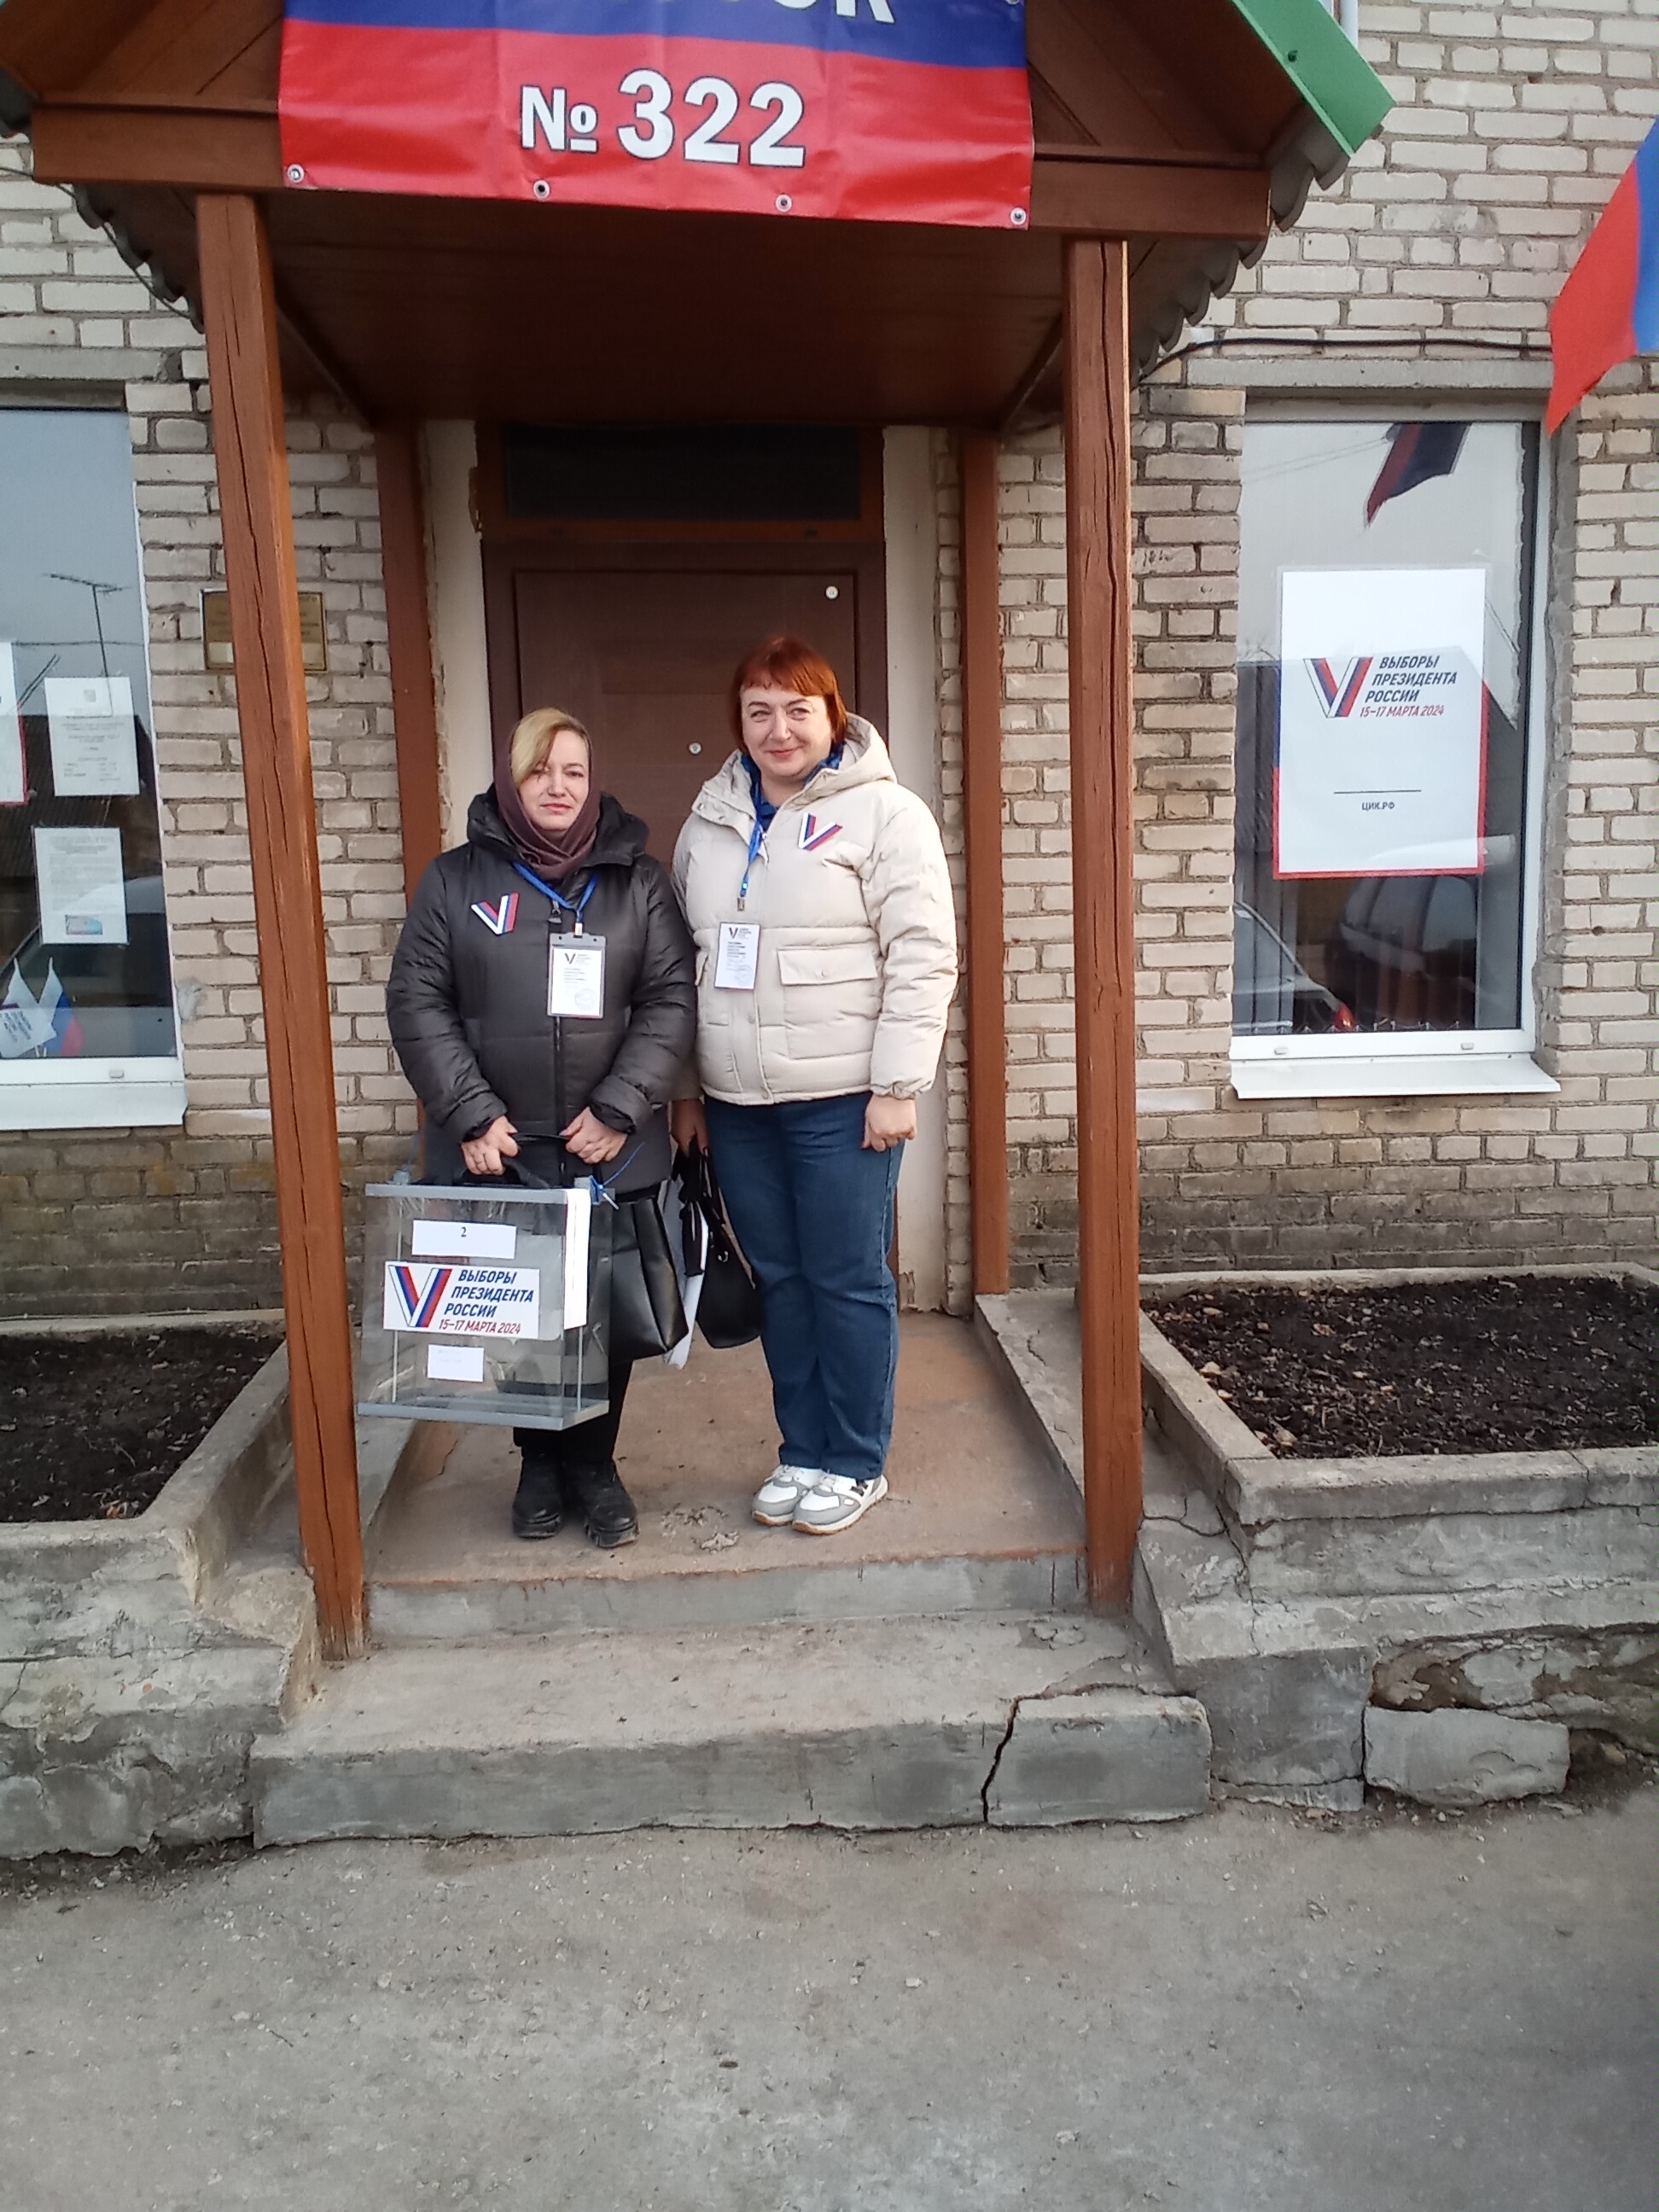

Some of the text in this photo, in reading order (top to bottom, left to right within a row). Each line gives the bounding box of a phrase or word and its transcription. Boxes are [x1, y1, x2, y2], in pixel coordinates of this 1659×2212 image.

[520, 68, 806, 168] № 322
[1379, 655, 1440, 669] ВЫБОРЫ
[1371, 672, 1458, 687] ПРЕЗИДЕНТА
[1365, 690, 1420, 703] РОССИИ
[1386, 705, 1420, 717] МАРТА
[1420, 704, 1444, 717] 2024
[1361, 801, 1395, 812] ЦИК.РФ
[460, 1226, 468, 1237] 2
[458, 1269, 517, 1284] ВЫБОРЫ
[451, 1286, 534, 1302] ПРЕЗИДЕНТА
[444, 1303, 498, 1318] РОССИИ
[464, 1320, 498, 1332] МАРТА
[498, 1322, 521, 1334] 2024
